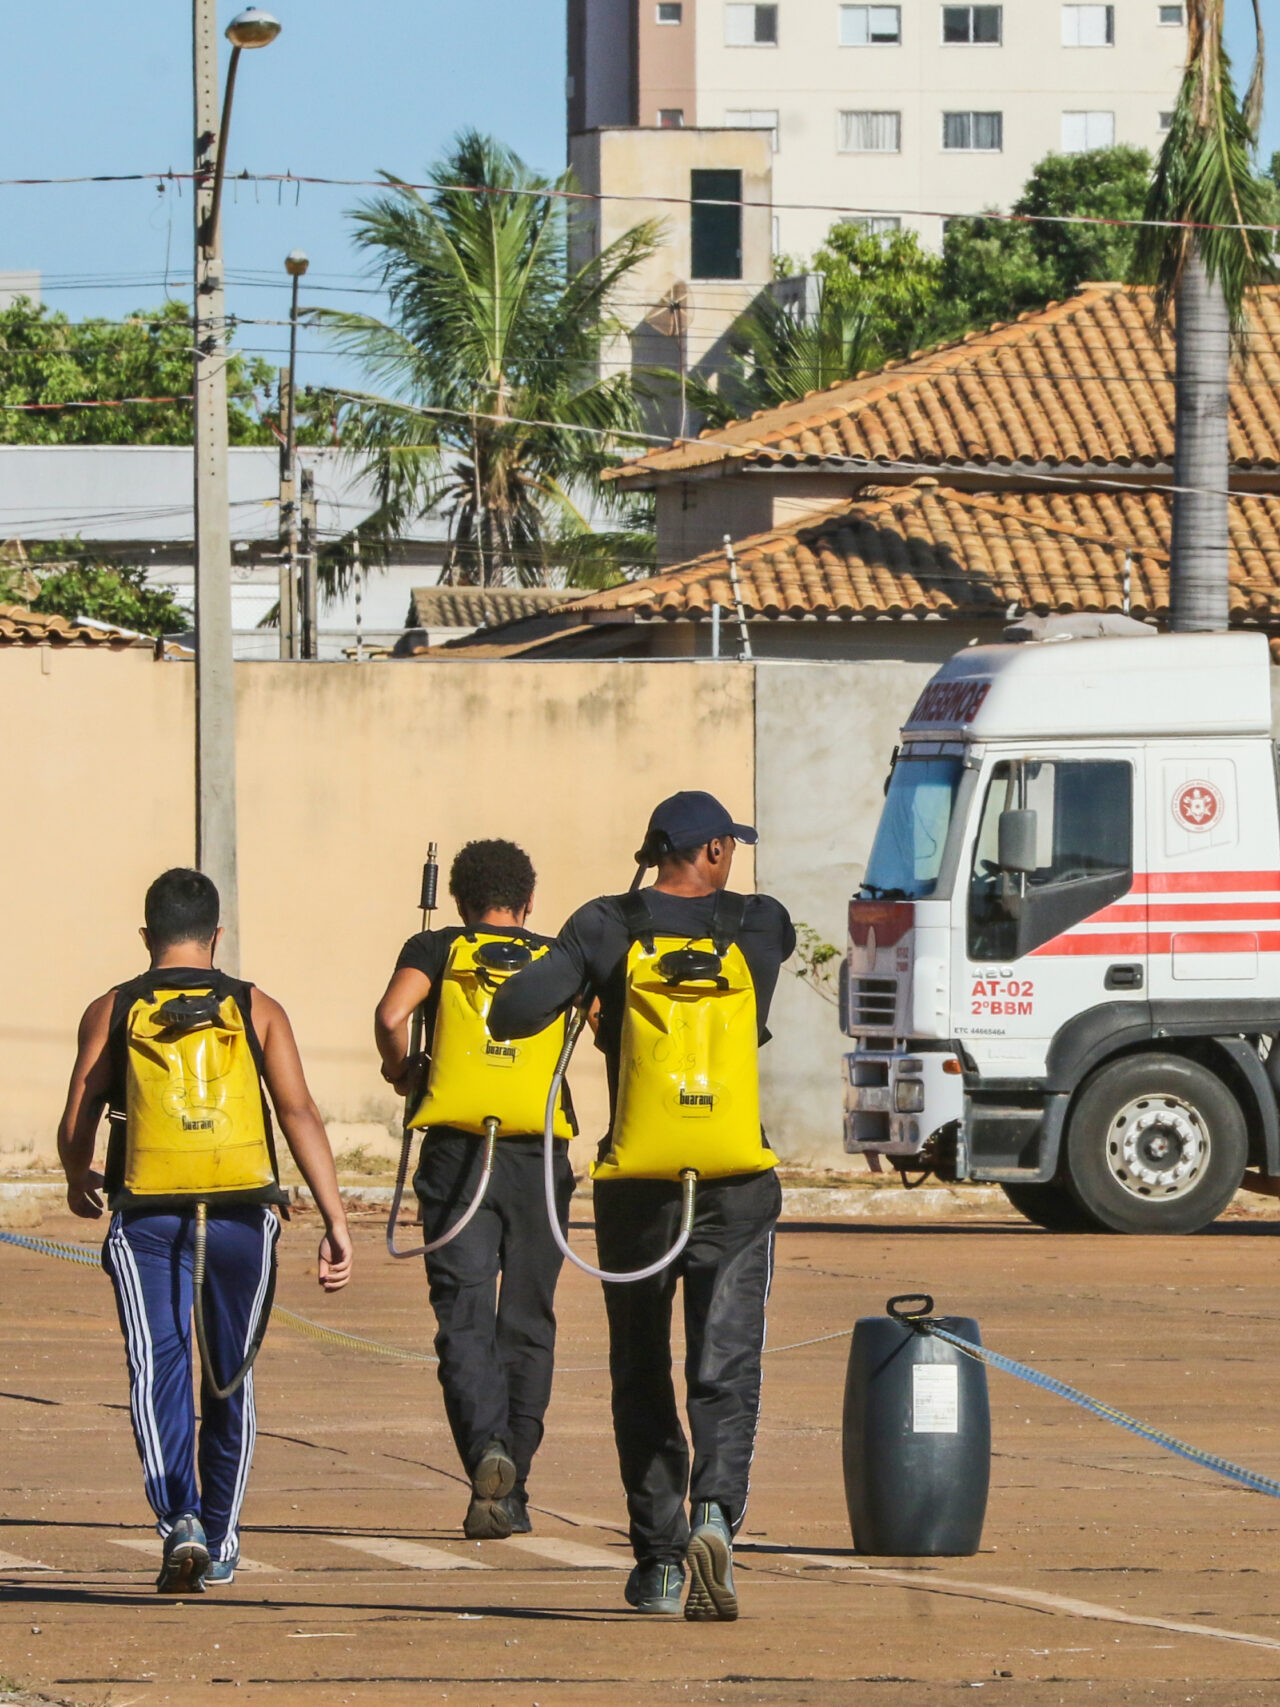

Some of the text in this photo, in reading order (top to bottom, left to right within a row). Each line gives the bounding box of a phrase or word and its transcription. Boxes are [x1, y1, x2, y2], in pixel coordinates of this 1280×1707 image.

[971, 981, 1034, 997] AT-02
[971, 1001, 1033, 1016] 2ºBBM
[485, 1039, 516, 1064] Guarany
[680, 1088, 714, 1113] Guarany
[182, 1115, 215, 1135] Guarany
